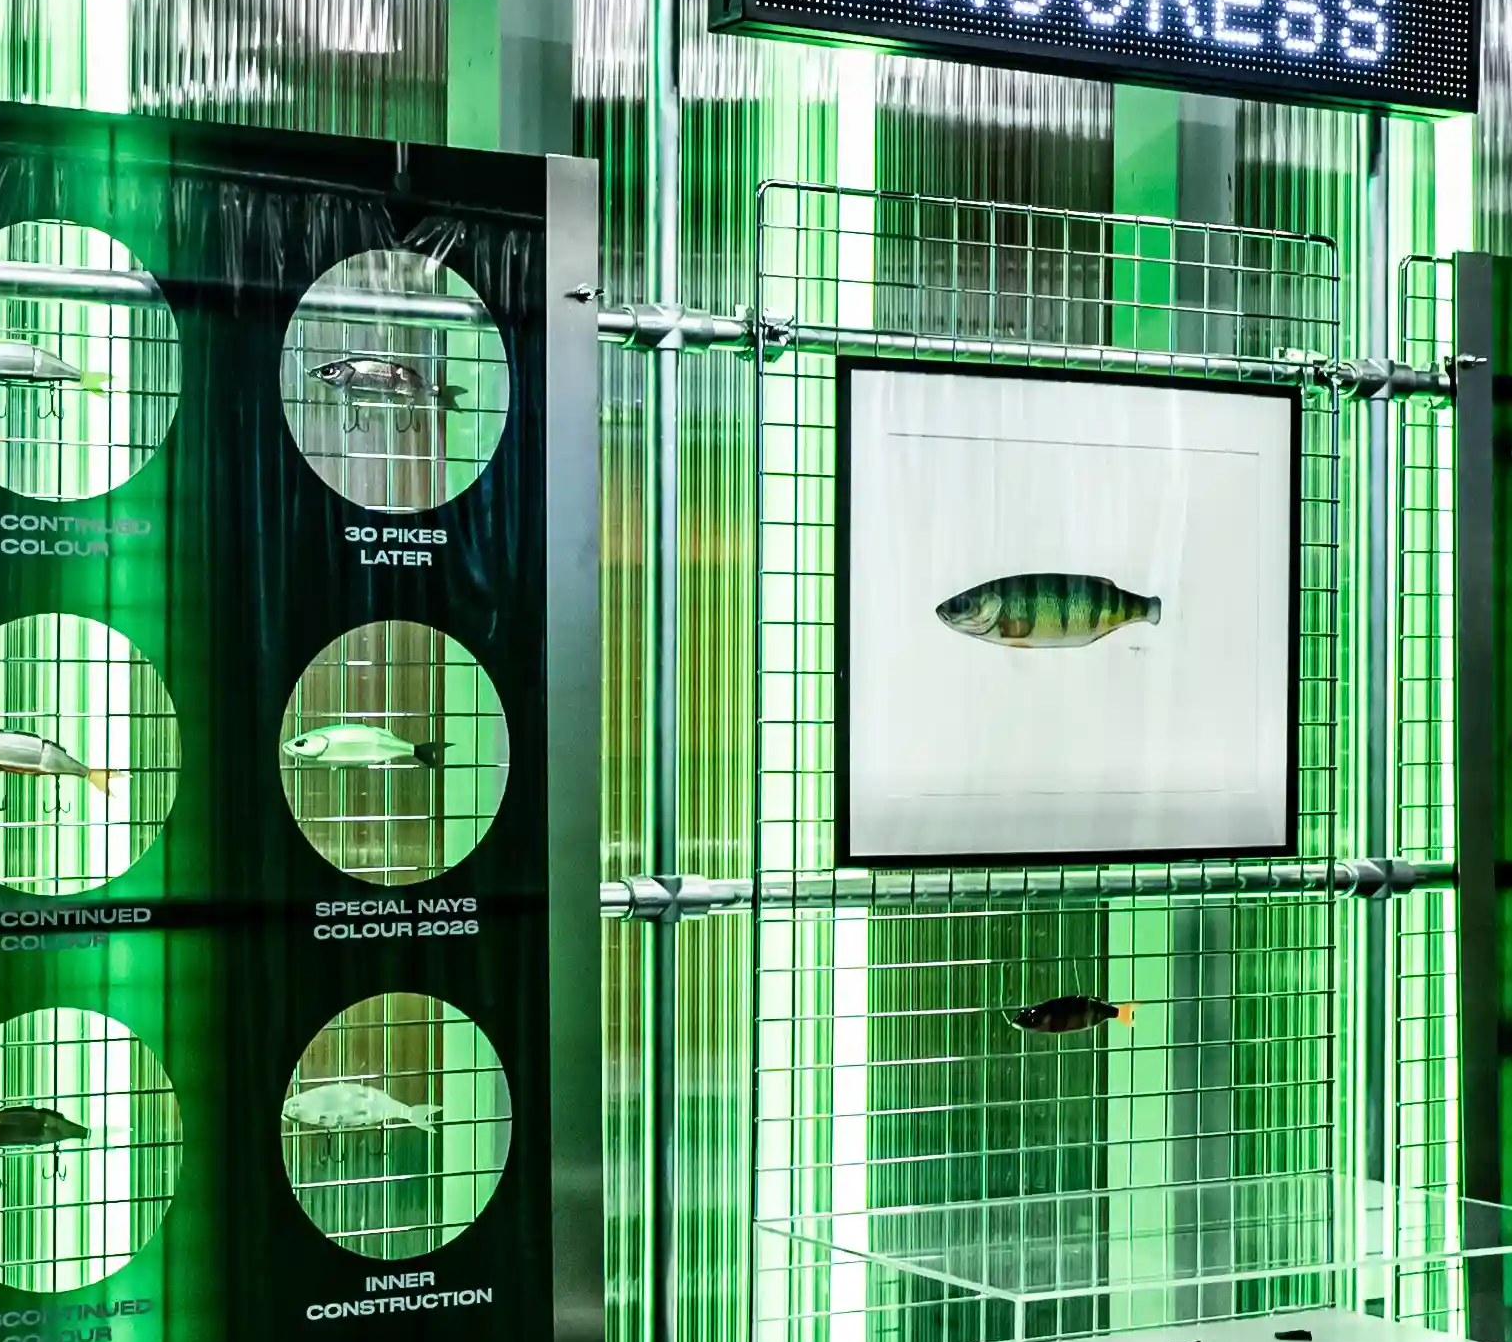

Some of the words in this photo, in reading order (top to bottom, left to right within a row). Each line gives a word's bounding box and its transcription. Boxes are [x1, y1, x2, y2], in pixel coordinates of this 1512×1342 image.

[344, 526, 378, 543] 30
[382, 527, 448, 544] PIKES
[0, 538, 109, 557] COLOUR
[360, 549, 433, 566] LATER
[315, 900, 413, 917] SPECIAL
[417, 897, 477, 914] NAYS
[313, 922, 413, 940] COLOUR
[417, 919, 480, 937] 2026
[365, 1271, 435, 1292] INNER
[306, 1287, 493, 1321] CONSTRUCTION
